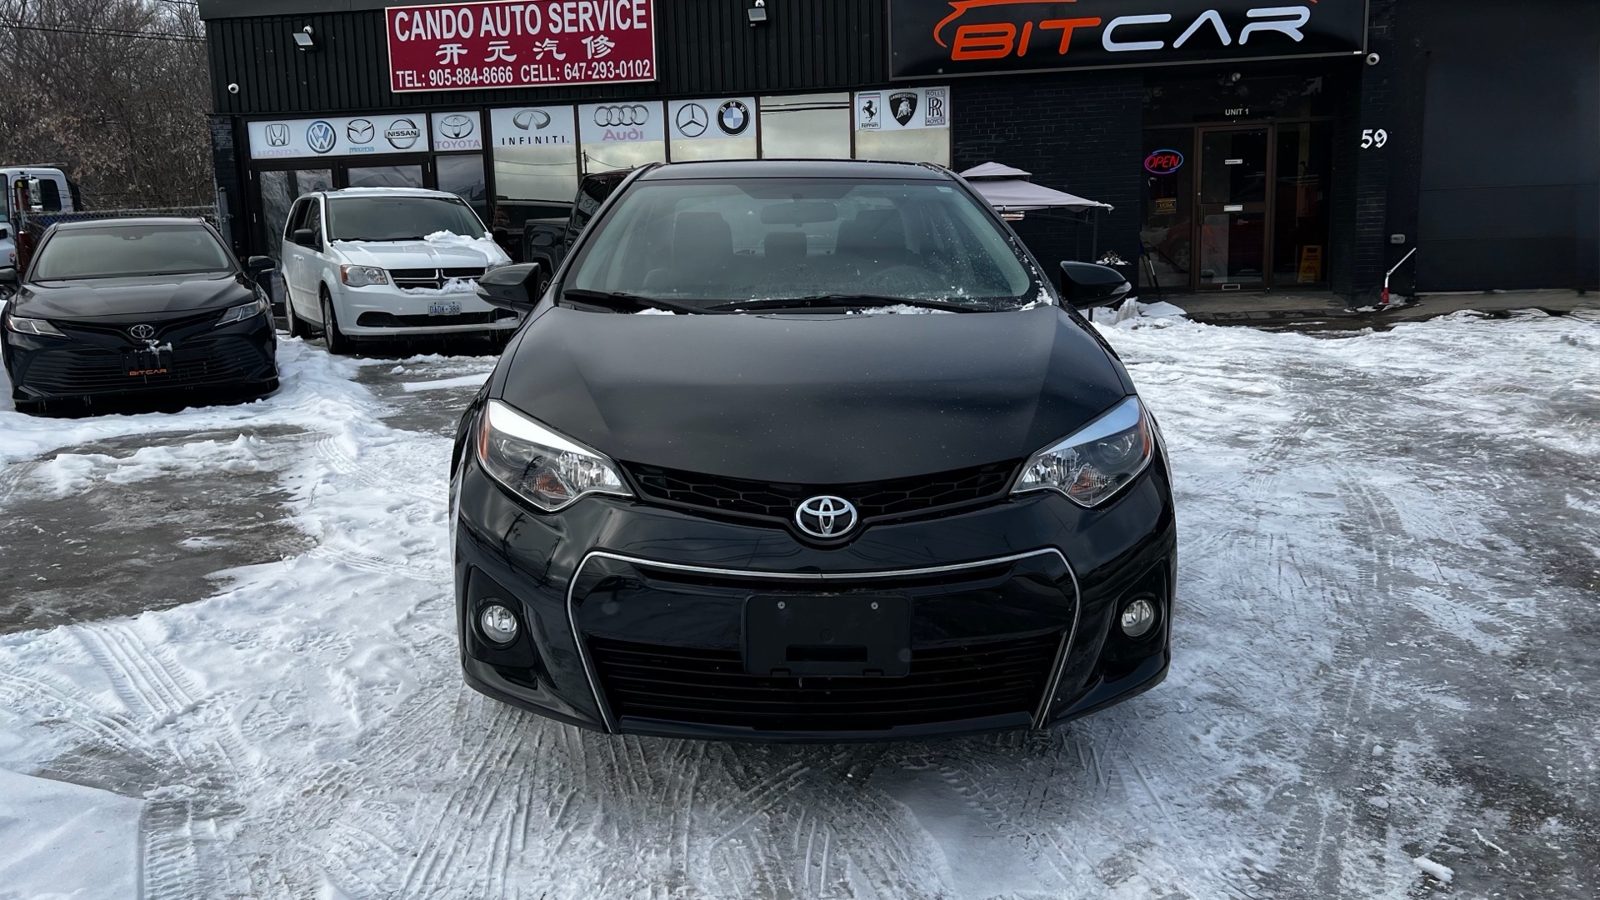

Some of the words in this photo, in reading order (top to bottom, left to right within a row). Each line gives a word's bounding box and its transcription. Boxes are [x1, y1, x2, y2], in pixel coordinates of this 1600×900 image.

[395, 7, 474, 41] CANDO
[480, 3, 541, 37] AUTO
[548, 0, 647, 33] SERVICE
[951, 5, 1311, 60] BITCAR
[435, 34, 615, 65] 开元汽修
[396, 70, 426, 88] TEL:
[429, 66, 513, 87] 905-884-8666
[520, 64, 560, 83] CELL:
[564, 59, 651, 81] 647-293-0102
[1225, 108, 1243, 116] UNIT
[387, 129, 417, 137] NISSAN
[603, 128, 644, 141] Audi
[1361, 128, 1388, 149] 59
[435, 139, 480, 150] TOYOTA
[502, 135, 566, 146] INFINITI
[256, 148, 301, 157] HONDA
[1147, 155, 1179, 169] OPEN
[129, 368, 167, 376] BITCAR
